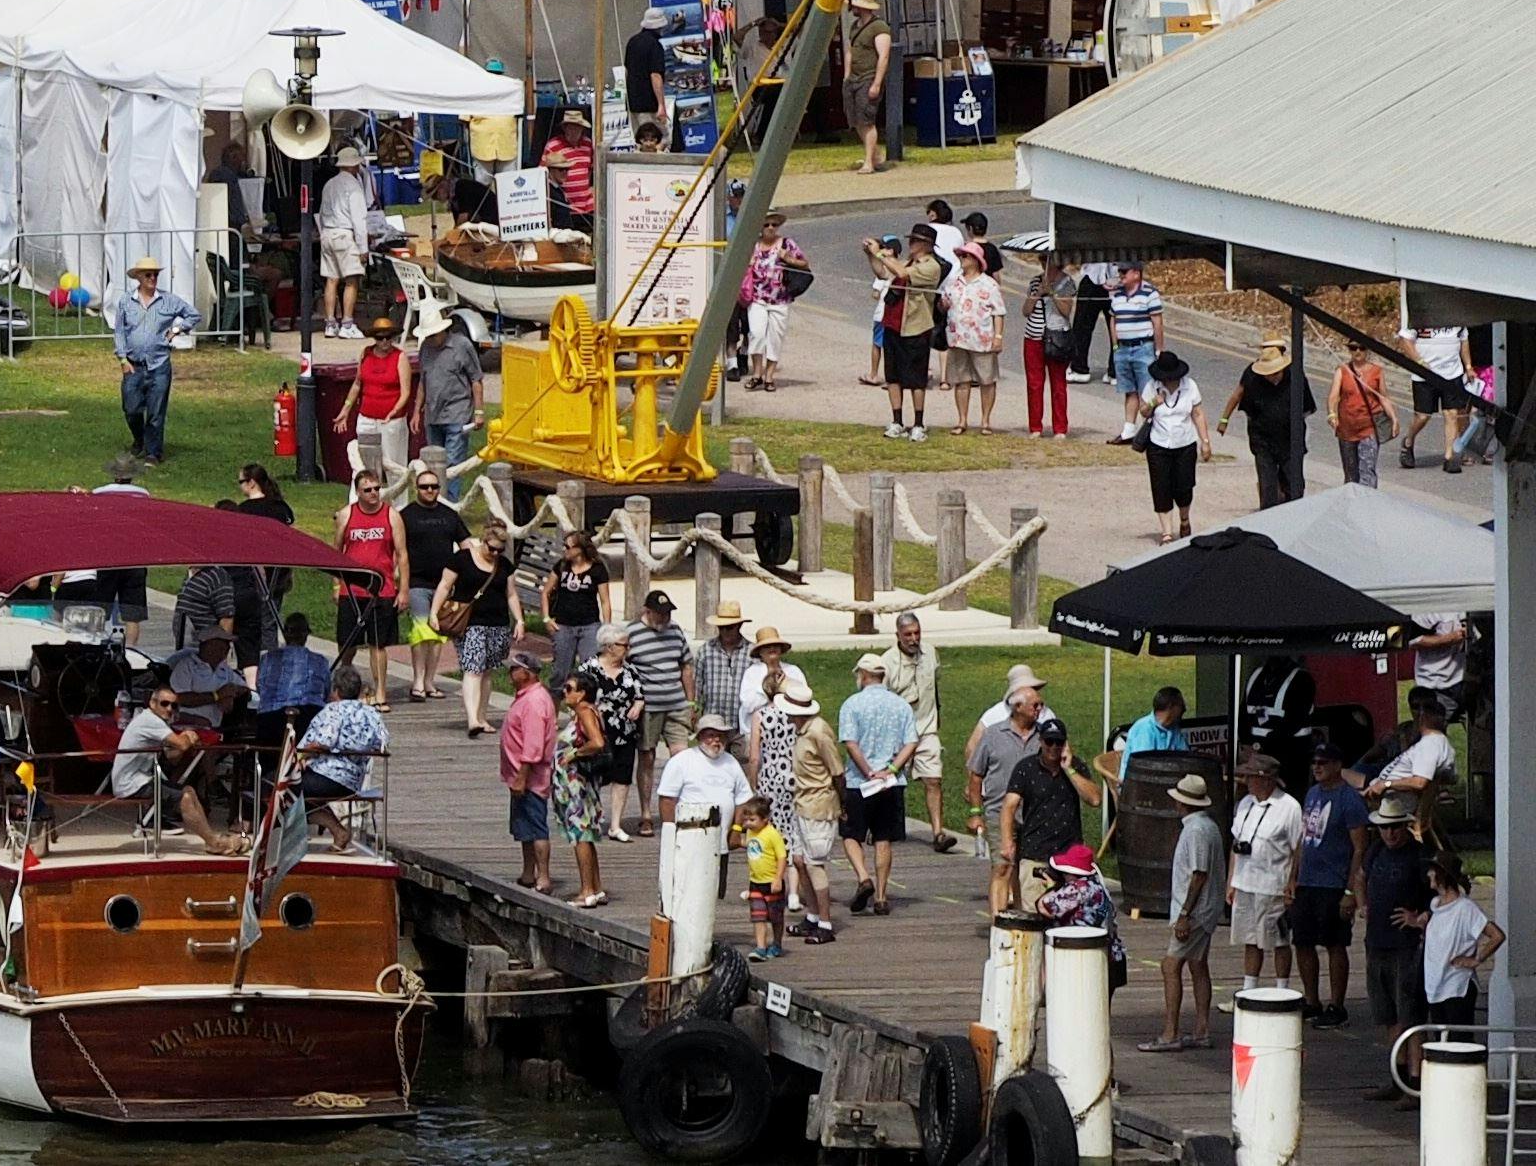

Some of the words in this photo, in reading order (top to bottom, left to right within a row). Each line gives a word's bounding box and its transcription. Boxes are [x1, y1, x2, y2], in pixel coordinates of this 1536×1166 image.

[645, 208, 659, 216] Home
[503, 221, 545, 234] VOLUNTEERS
[1208, 635, 1234, 645] Coffee
[1236, 635, 1284, 646] Experience
[1189, 730, 1219, 744] NOW
[150, 1027, 191, 1056] M.V.
[193, 1018, 254, 1041] MARY
